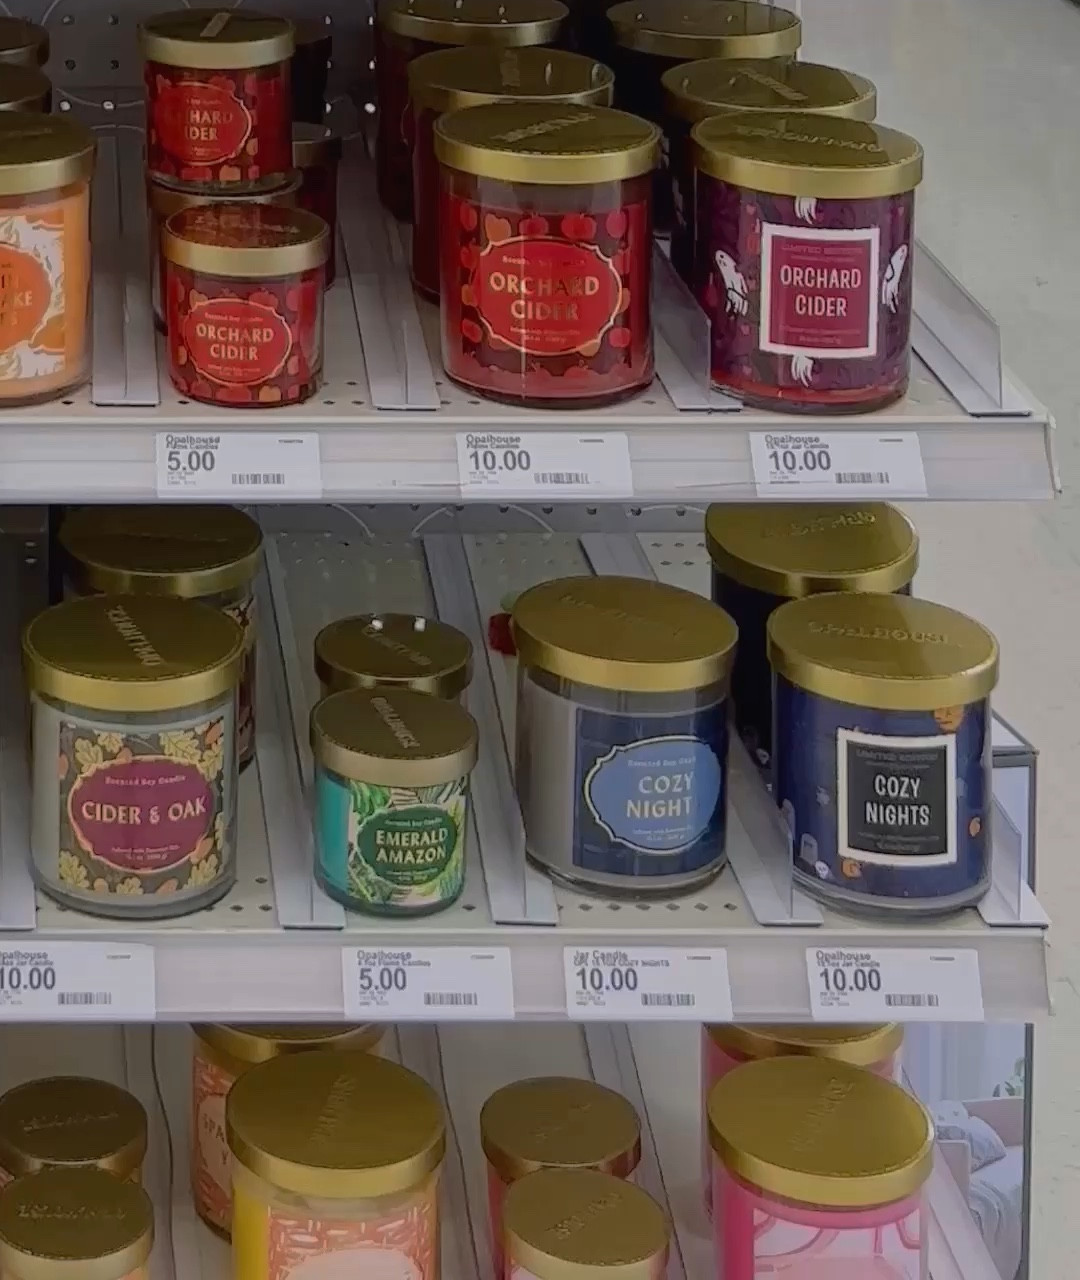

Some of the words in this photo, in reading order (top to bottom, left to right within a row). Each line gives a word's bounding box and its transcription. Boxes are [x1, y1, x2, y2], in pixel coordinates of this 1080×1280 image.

[488, 270, 600, 297] ORCHARD
[779, 263, 862, 291] ORCHARD
[510, 299, 580, 322] CIDER
[794, 293, 848, 319] CIDER
[195, 323, 276, 343] ORCHARD
[209, 343, 259, 362] CIDER
[167, 450, 215, 471] 5.00
[468, 449, 531, 471] 10.00
[768, 450, 832, 471] 10.00
[638, 771, 694, 795] COZY
[873, 775, 921, 800] COZY
[80, 800, 142, 826] CIDER
[148, 805, 161, 825] &
[167, 795, 208, 820] OAK
[864, 803, 930, 827] NIGHTS
[375, 826, 448, 847] EMERALD
[375, 847, 447, 866] AMAZON
[359, 967, 407, 990] 5.00
[575, 967, 638, 991] 10.00
[819, 967, 881, 991] 10.00
